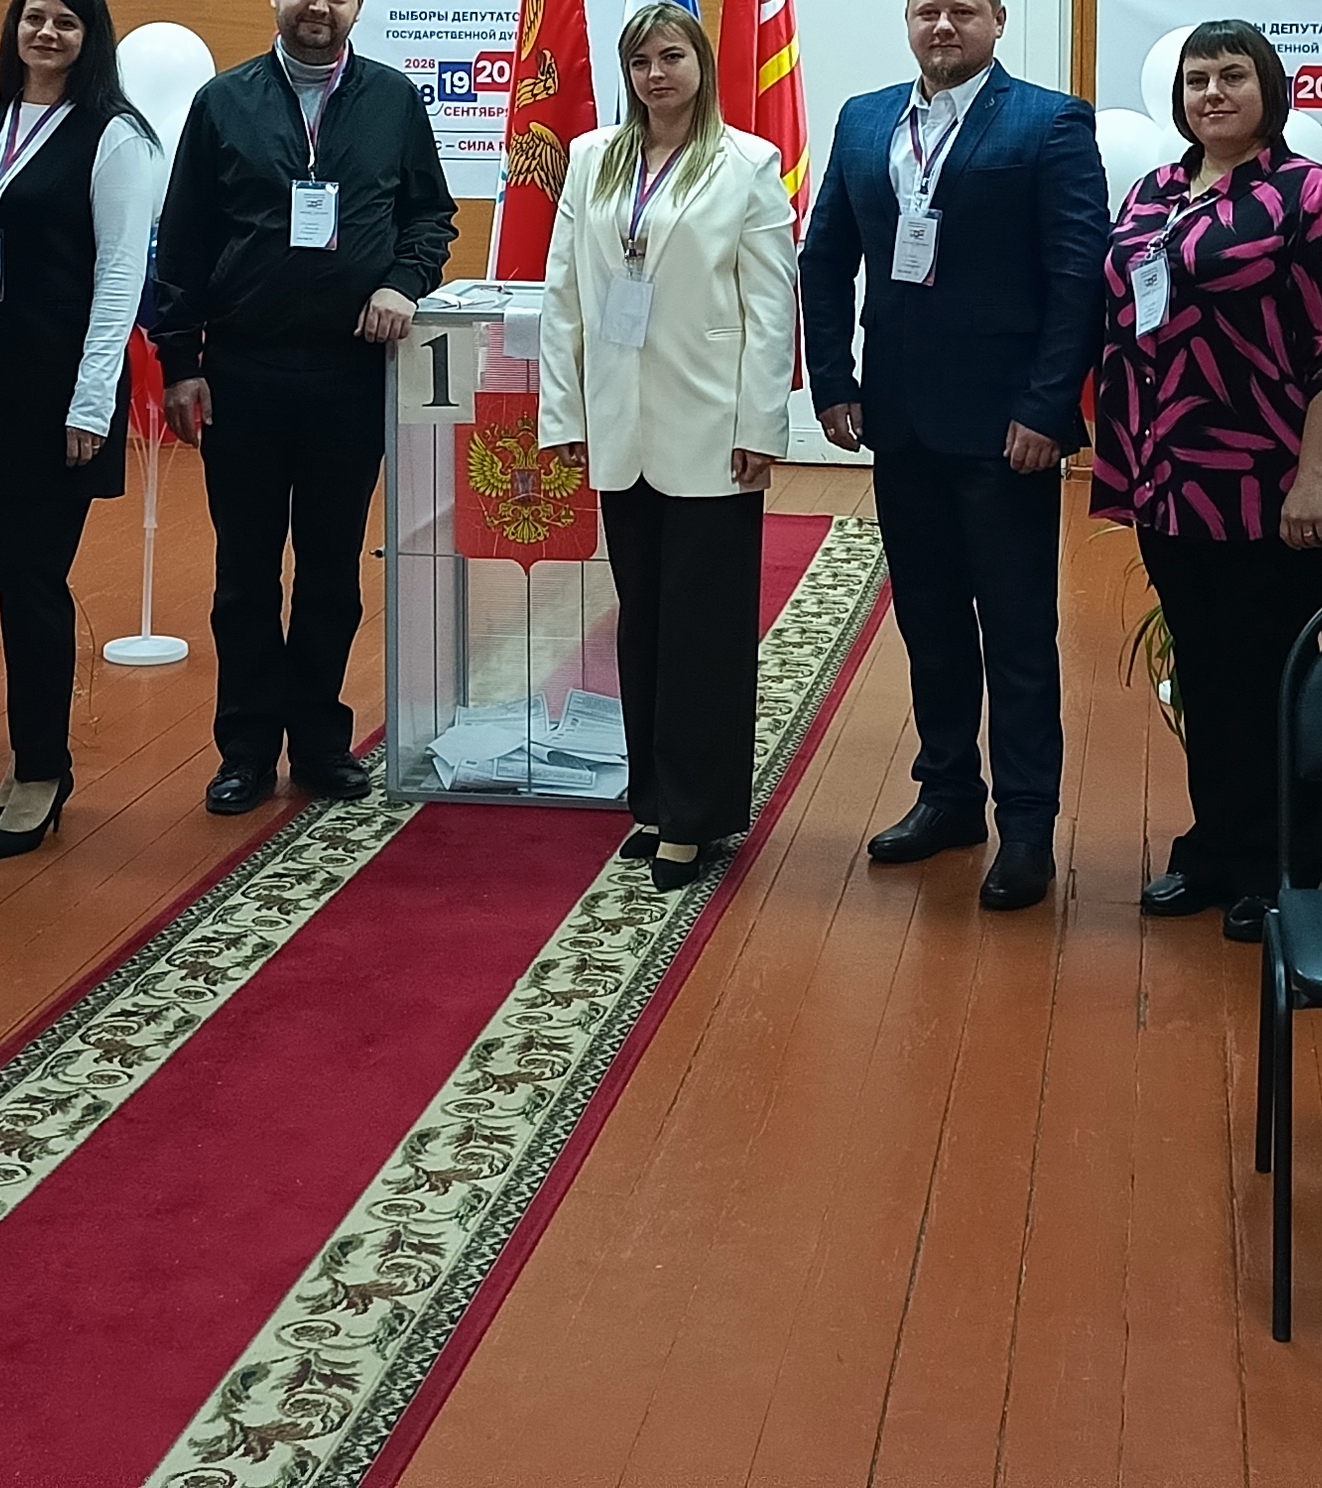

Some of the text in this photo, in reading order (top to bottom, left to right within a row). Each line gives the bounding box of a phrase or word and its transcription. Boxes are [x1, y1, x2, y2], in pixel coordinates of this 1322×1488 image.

[389, 11, 448, 22] ВЫБОРЫ
[385, 29, 518, 41] ГОСУДАРСТВЕННОЙ ДУ
[404, 58, 436, 69] 2026
[441, 70, 470, 94] 19
[476, 60, 511, 83] 20
[458, 140, 496, 152] СИЛА
[420, 332, 460, 408] 1
